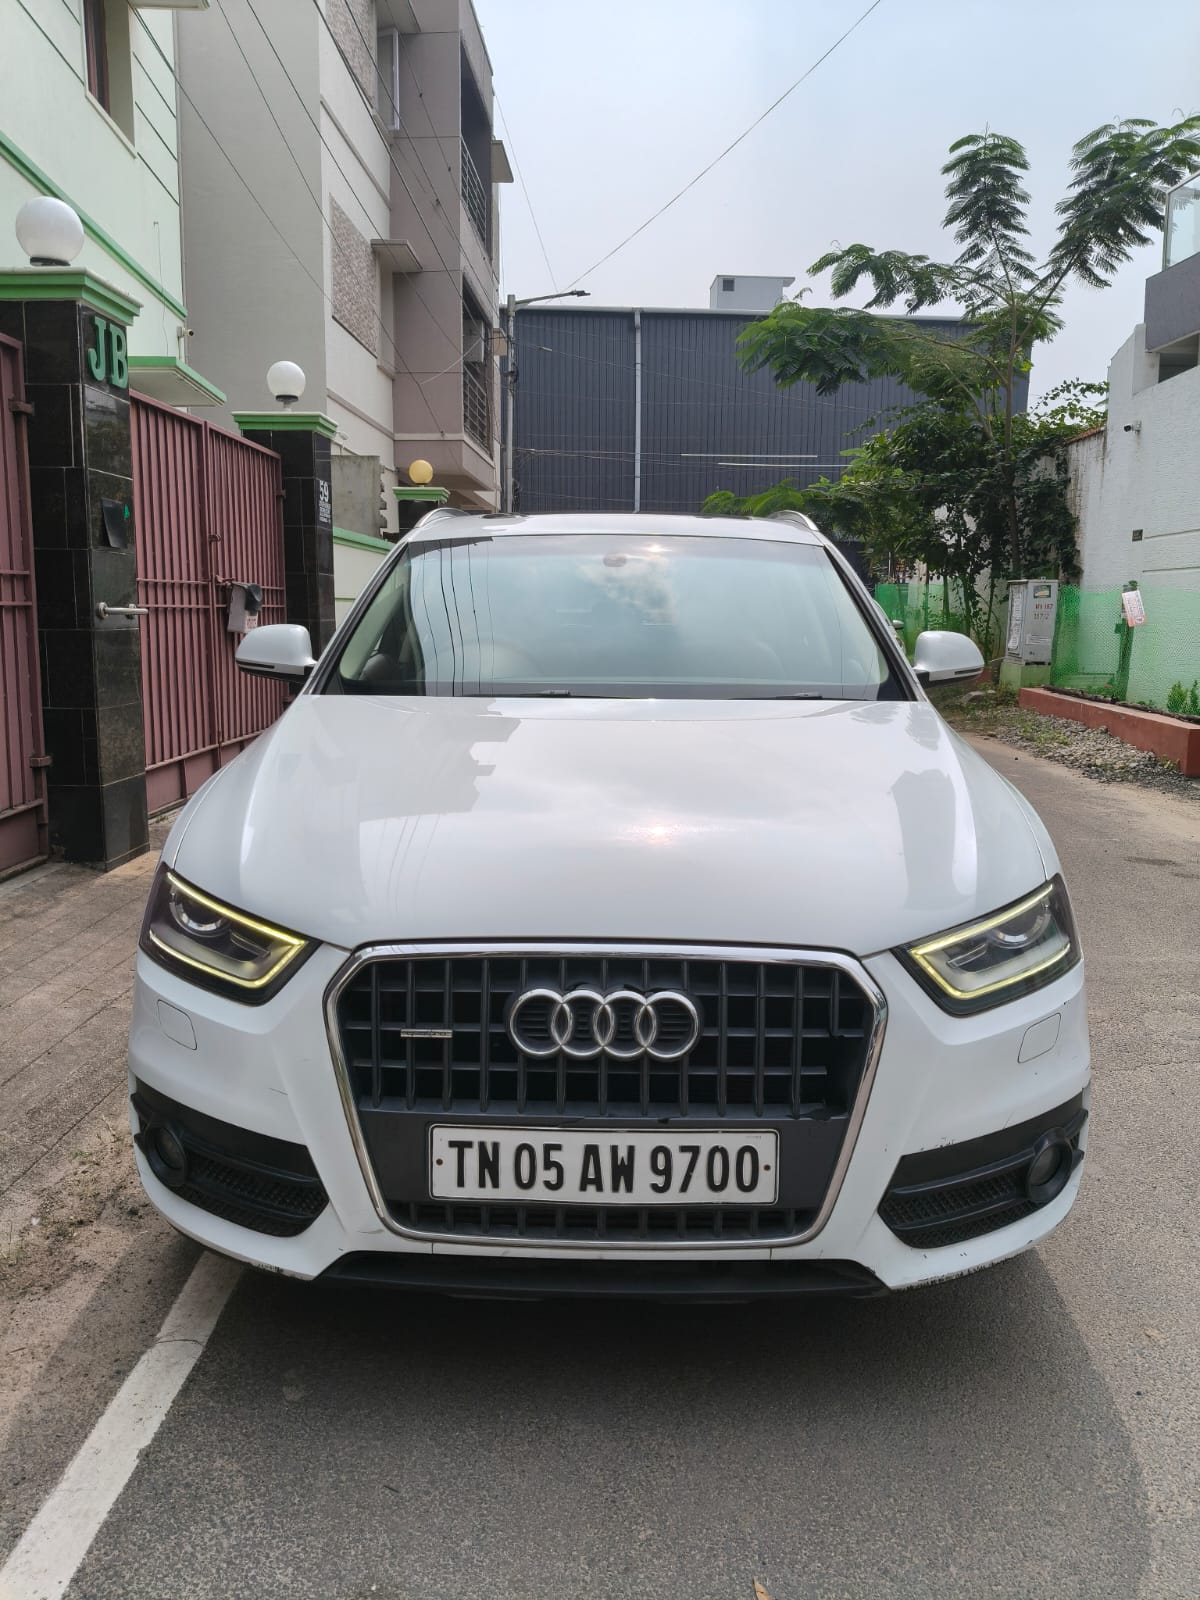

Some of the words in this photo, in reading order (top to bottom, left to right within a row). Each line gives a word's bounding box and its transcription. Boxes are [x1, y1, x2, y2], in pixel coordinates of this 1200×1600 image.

[87, 315, 129, 389] JB
[319, 480, 329, 502] 59
[448, 1140, 500, 1189] TN
[514, 1143, 565, 1191] 05
[579, 1144, 635, 1193] AW
[650, 1145, 760, 1193] 9700
